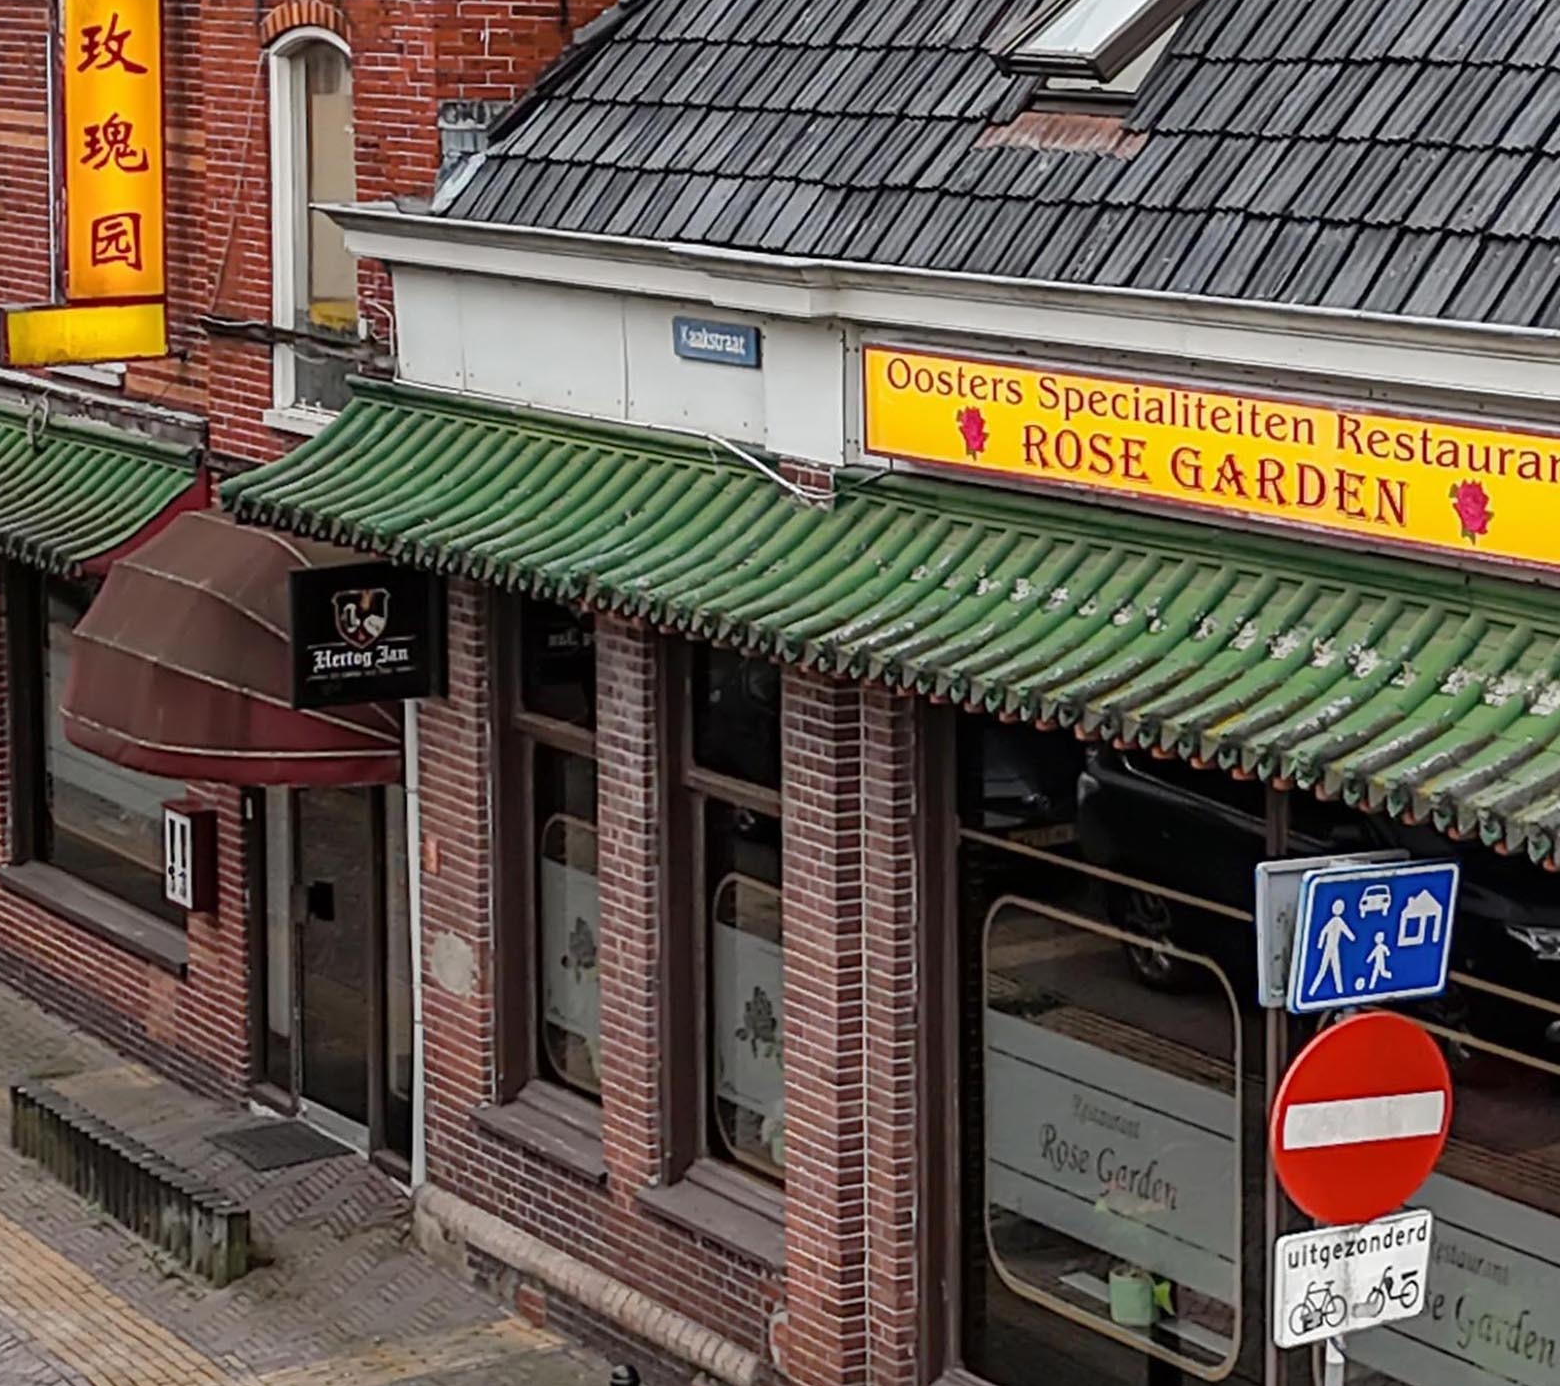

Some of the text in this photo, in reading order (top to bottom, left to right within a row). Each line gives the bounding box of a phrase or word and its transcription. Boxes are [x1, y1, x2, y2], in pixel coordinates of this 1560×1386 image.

[77, 13, 149, 271] 玫瑰园
[887, 357, 1023, 405] Oosters
[1038, 376, 1316, 446] Specialiteiten
[1023, 424, 1409, 527] ROSE GARDEN
[1040, 1123, 1178, 1211] Rose Garden
[1288, 1218, 1428, 1270] uitgezonderd
[1455, 1295, 1556, 1369] Garden
